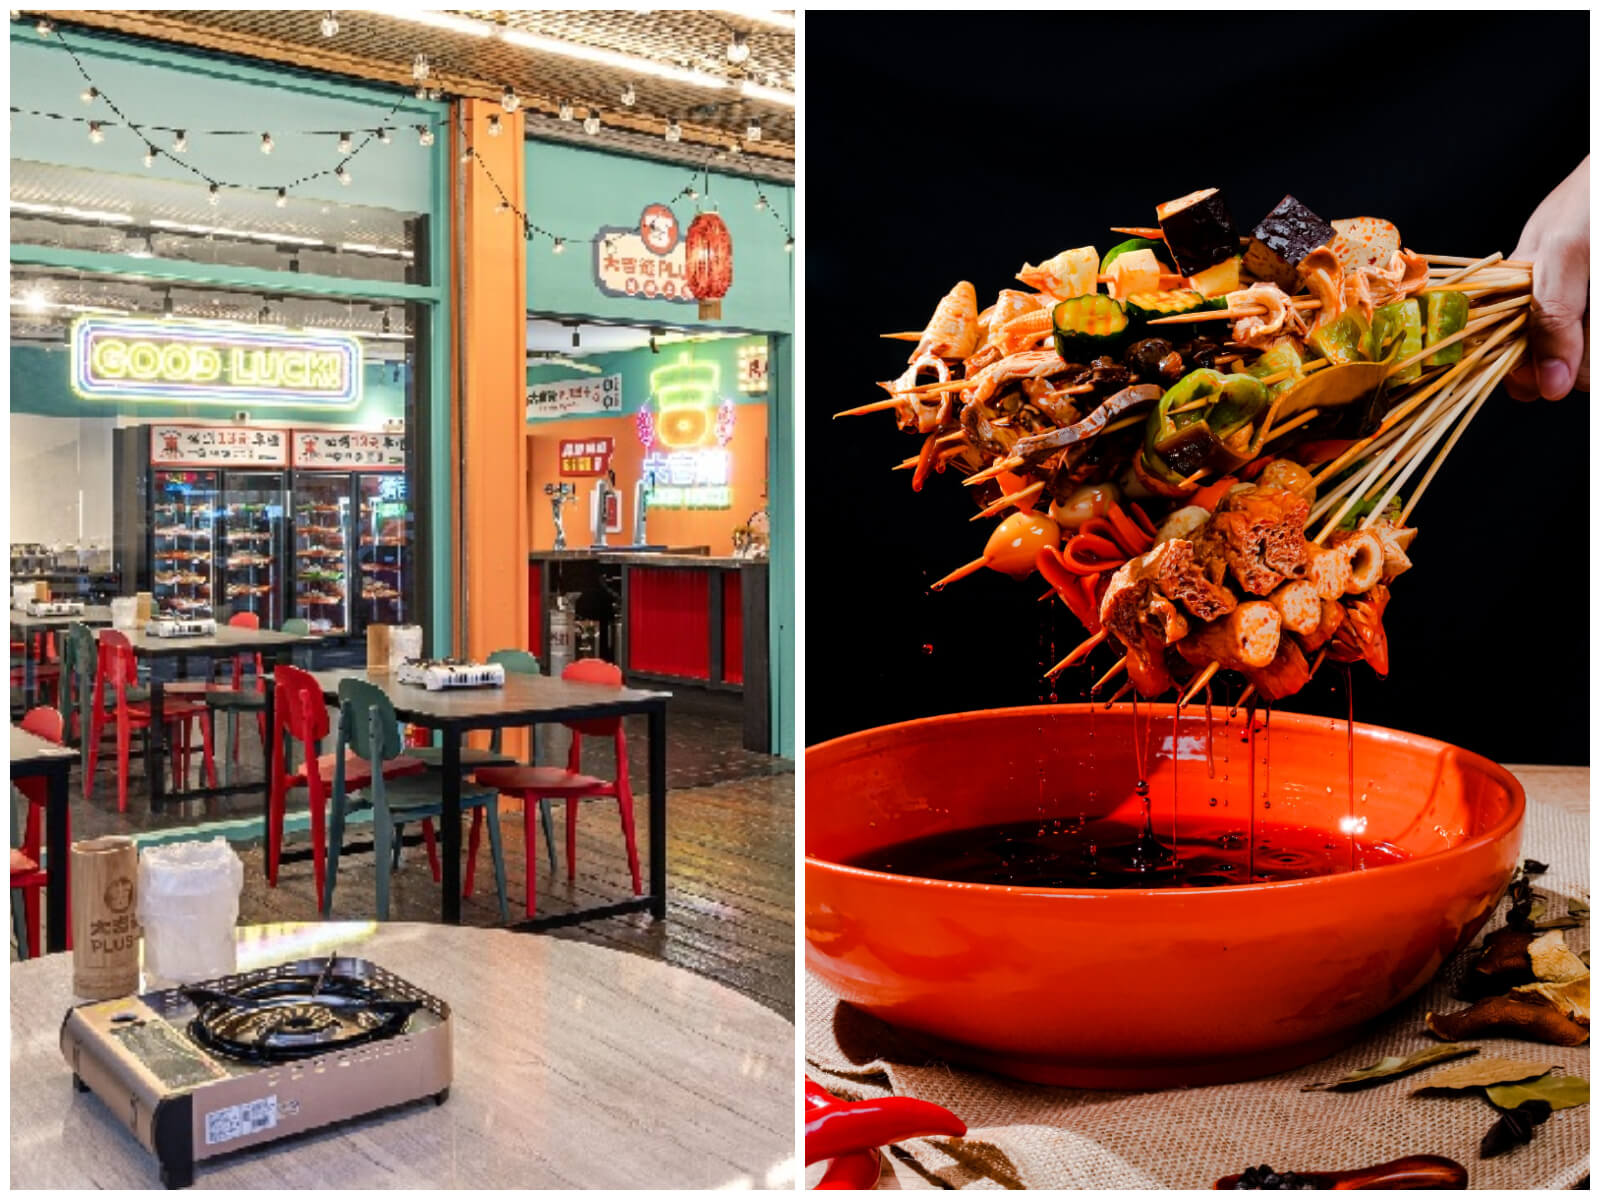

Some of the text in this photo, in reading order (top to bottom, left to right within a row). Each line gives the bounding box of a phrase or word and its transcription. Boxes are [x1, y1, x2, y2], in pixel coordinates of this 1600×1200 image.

[94, 339, 341, 389] GOOD LUCK!
[90, 935, 133, 953] PLUS
